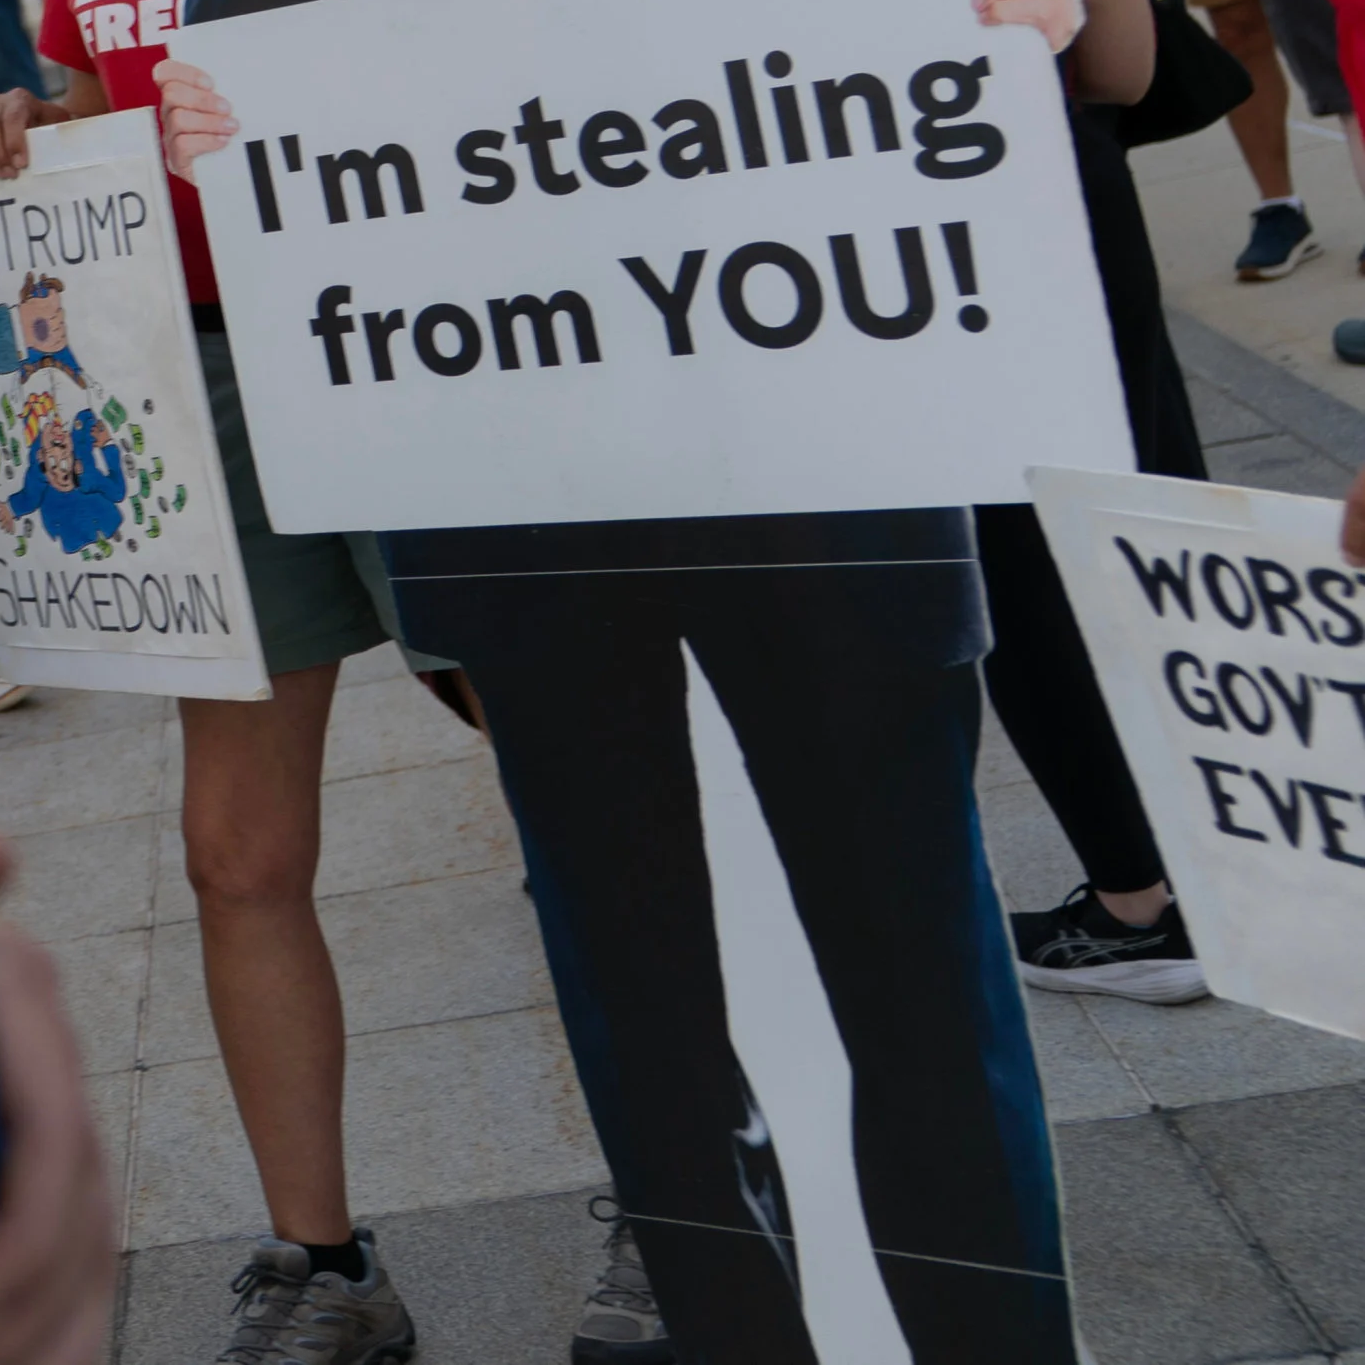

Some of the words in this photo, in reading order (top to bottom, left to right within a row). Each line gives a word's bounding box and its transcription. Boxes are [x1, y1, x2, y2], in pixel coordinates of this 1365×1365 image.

[245, 134, 425, 233] I'm
[457, 49, 1008, 205] stealing
[309, 284, 602, 386] from
[617, 220, 993, 359] YOU!
[1113, 535, 1365, 648] WORS
[1192, 755, 1365, 869] EVE
